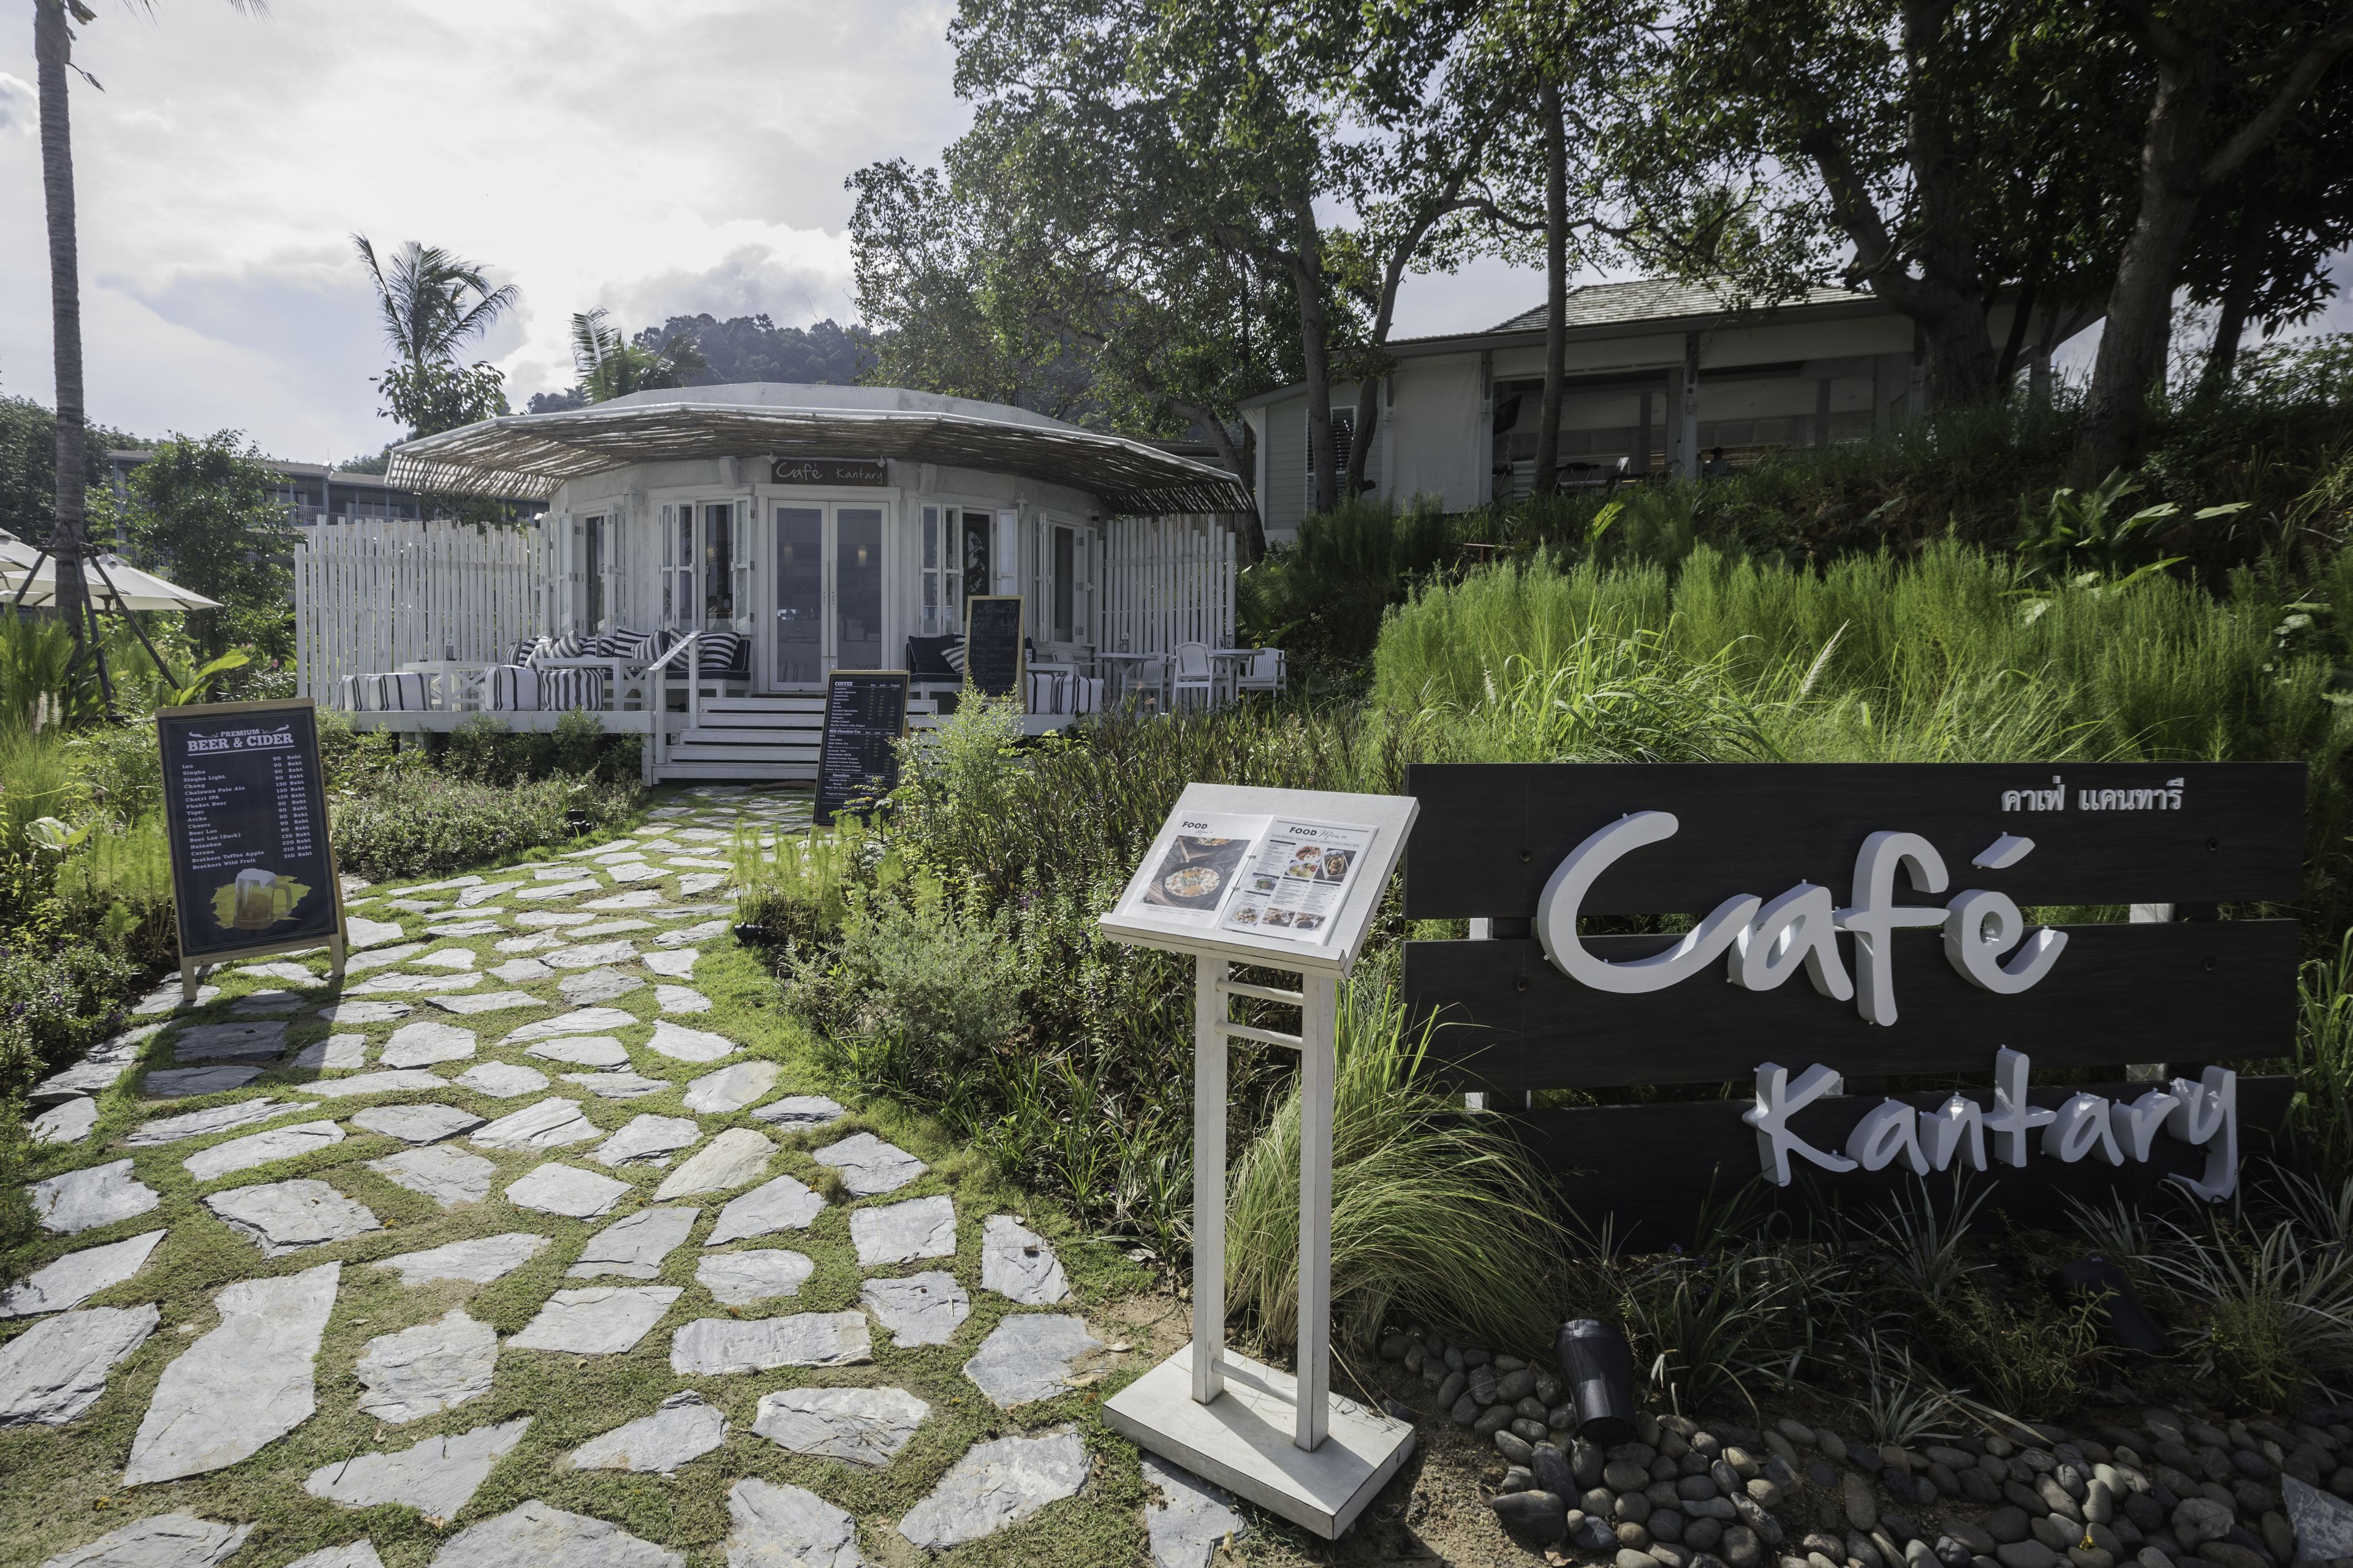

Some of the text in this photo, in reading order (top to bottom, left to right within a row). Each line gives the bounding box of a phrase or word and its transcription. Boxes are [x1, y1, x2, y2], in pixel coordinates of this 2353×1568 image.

[776, 462, 883, 485] Café Kantary
[187, 733, 294, 751] BEER & CIDER
[221, 729, 260, 737] PREMIUM
[2001, 775, 2184, 811] คาเฟ่ แคนทารี
[1289, 827, 1347, 840] FOOD Menu
[1537, 810, 2069, 1027] Café
[1741, 1046, 2238, 1203] Kantary
